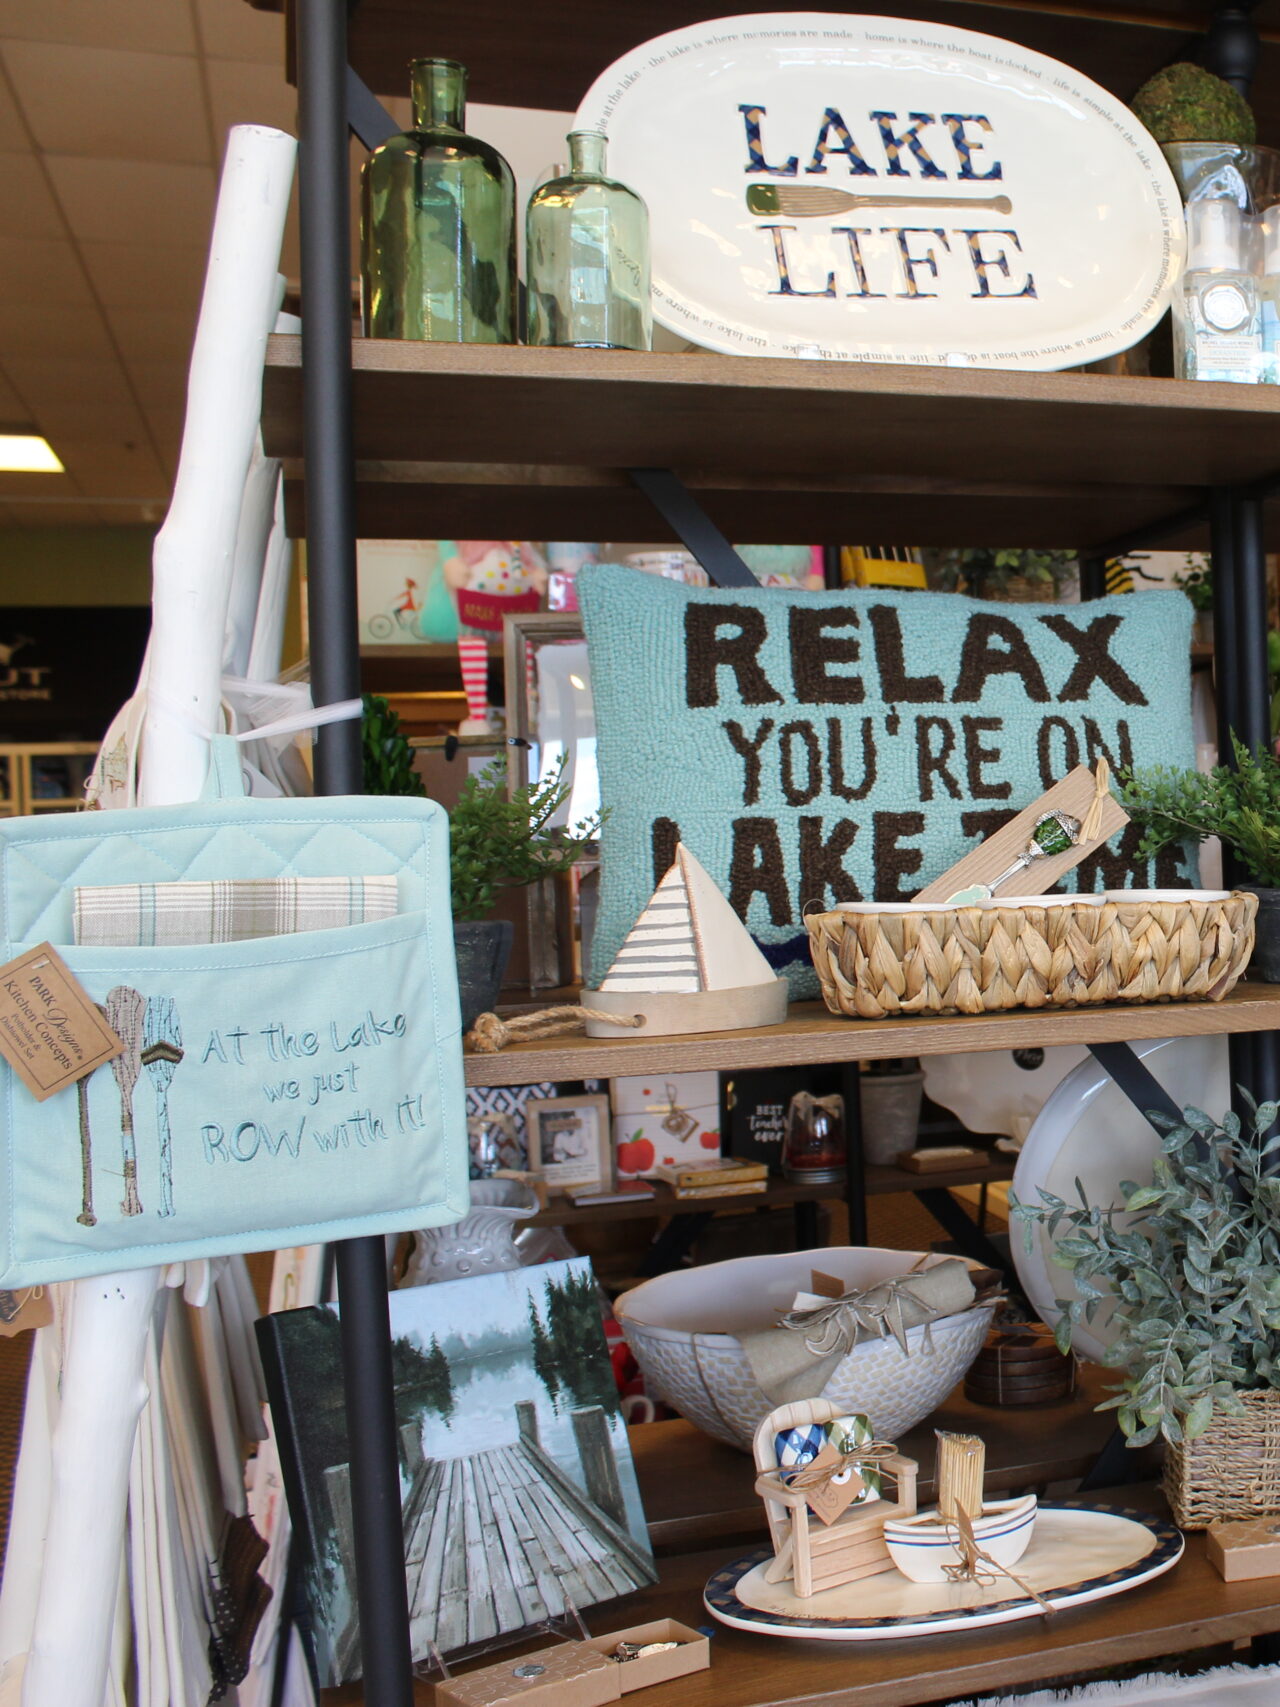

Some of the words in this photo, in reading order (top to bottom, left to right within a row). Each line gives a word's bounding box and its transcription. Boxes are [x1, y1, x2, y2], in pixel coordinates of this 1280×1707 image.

[648, 53, 668, 68] the
[667, 44, 691, 59] lake
[692, 40, 703, 50] is
[705, 33, 740, 47] where
[742, 29, 797, 40] memories
[799, 30, 819, 38] are
[822, 29, 854, 40] made
[865, 31, 895, 43] home
[898, 35, 908, 44] is
[911, 36, 945, 50] where
[947, 43, 966, 55] the
[968, 46, 992, 62] boat
[994, 54, 1004, 66] is
[1003, 57, 1042, 80] docked
[603, 105, 613, 118] at
[608, 88, 624, 105] the
[619, 70, 642, 91] lake
[1053, 75, 1070, 91] life
[1071, 86, 1081, 98] is
[1083, 94, 1116, 123] simple
[1113, 121, 1125, 133] at
[1122, 132, 1138, 148] the
[1136, 149, 1152, 171] lake
[738, 103, 1002, 181] LAKE
[1151, 179, 1161, 196] the
[1157, 197, 1168, 218] lake
[1162, 217, 1170, 227] is
[1162, 228, 1171, 257] where
[755, 224, 1038, 299] LIFE
[666, 298, 700, 321] where
[1140, 299, 1155, 314] are
[702, 318, 714, 330] is
[1120, 311, 1142, 331] made
[717, 324, 745, 343] lake
[746, 334, 768, 348] the
[1087, 329, 1114, 346] home
[1040, 340, 1073, 356] where
[1074, 338, 1087, 349] is
[835, 350, 849, 360] at
[851, 351, 896, 363] simple
[898, 354, 909, 363] is
[909, 353, 930, 364] life
[980, 351, 991, 361] is
[992, 348, 1018, 361] boat
[1020, 347, 1039, 360] the
[684, 601, 1149, 708] RELAX
[723, 704, 1012, 808] YOU'RE
[1037, 714, 1134, 794] ON
[28, 976, 57, 1008] PARK
[3, 979, 38, 1023] Kitchen
[35, 1022, 73, 1070] Concepts
[11, 1013, 36, 1045] Potholder
[259, 1021, 321, 1062] the
[329, 1010, 407, 1053] Lake
[24, 1048, 35, 1060] Set
[263, 1079, 300, 1103] we
[308, 1061, 360, 1106] just
[756, 1104, 783, 1116] BEST
[200, 1115, 306, 1165] ROW
[313, 1108, 389, 1153] with
[754, 1131, 785, 1143] ever
